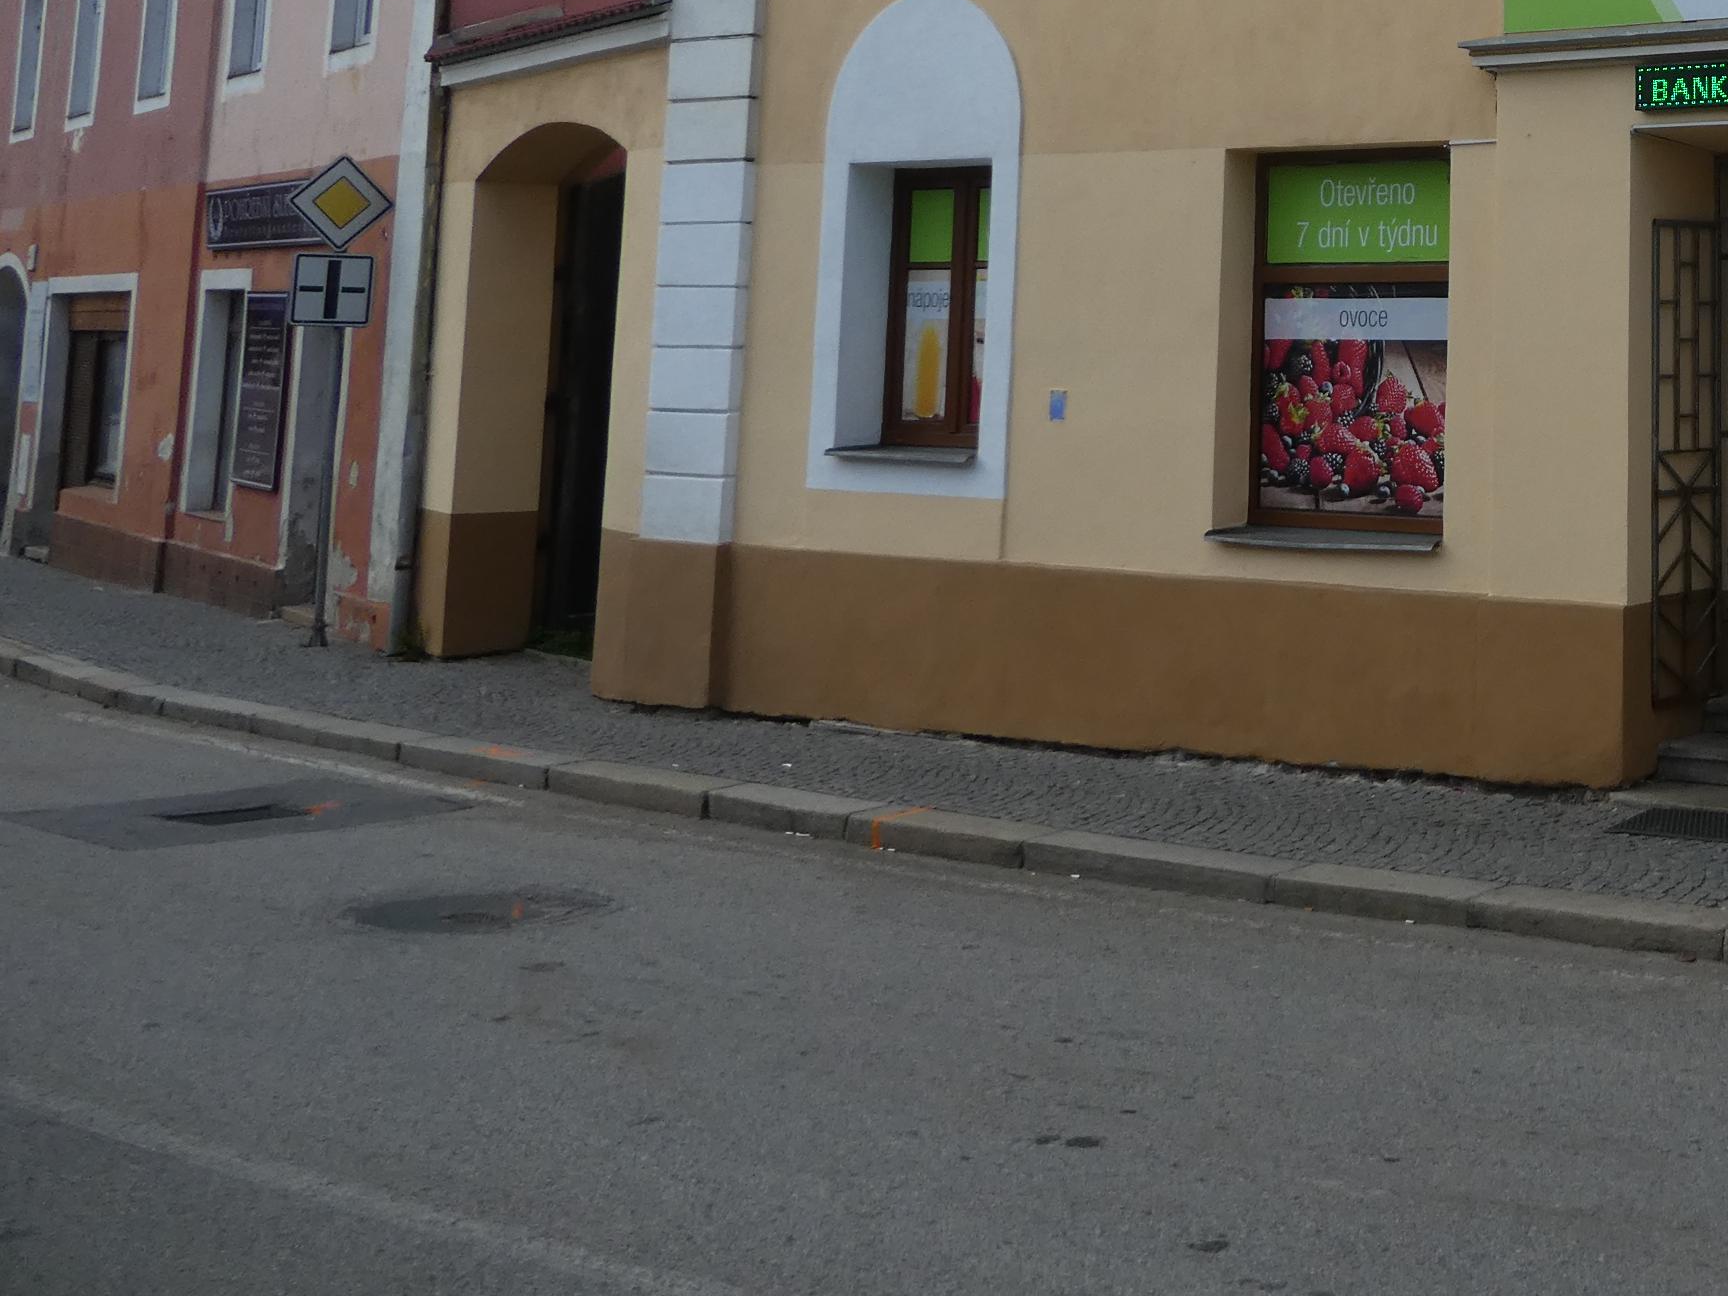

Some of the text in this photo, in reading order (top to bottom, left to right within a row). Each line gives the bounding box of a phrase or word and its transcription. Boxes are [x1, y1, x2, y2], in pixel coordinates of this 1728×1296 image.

[1320, 177, 1415, 207] Otevřeno
[1296, 219, 1438, 252] 7 dní v týdnu
[908, 288, 950, 312] nápoje
[1339, 308, 1388, 328] ovoce
